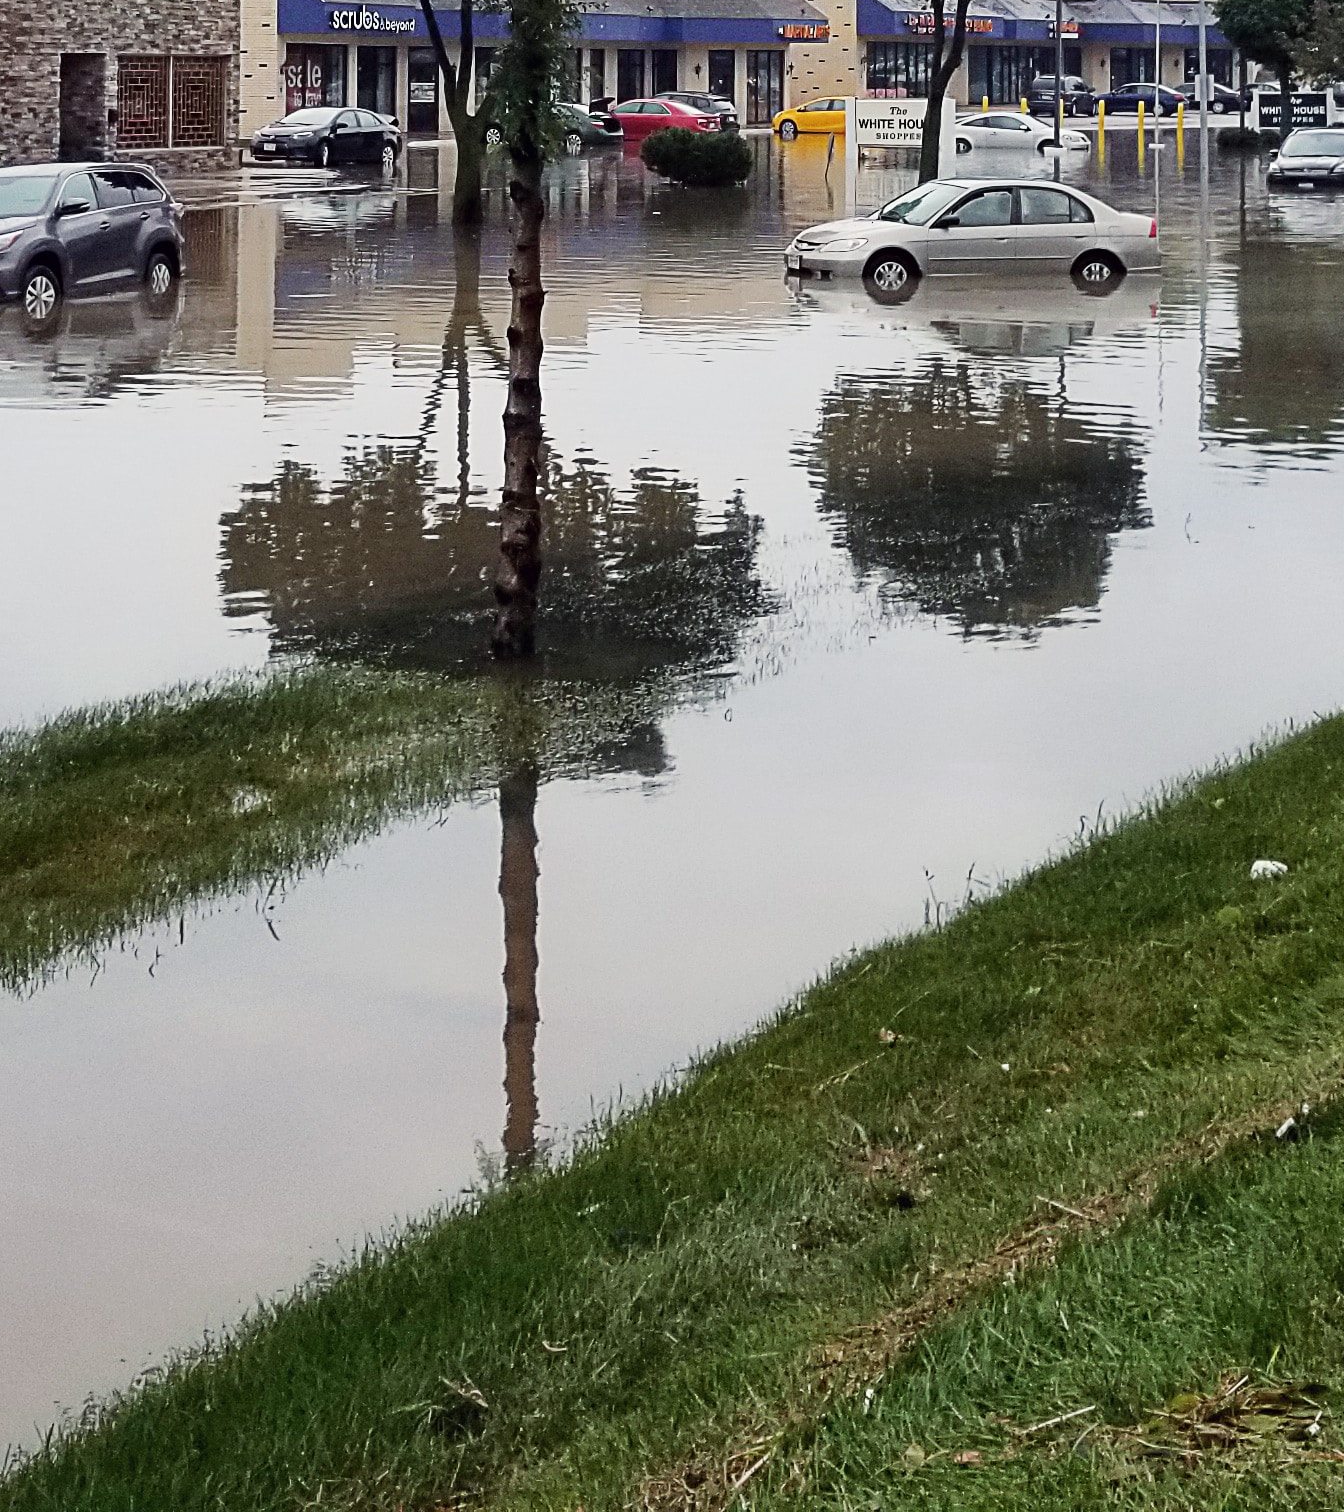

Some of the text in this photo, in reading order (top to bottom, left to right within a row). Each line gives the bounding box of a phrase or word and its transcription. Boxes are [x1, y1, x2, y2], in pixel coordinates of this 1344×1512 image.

[333, 5, 380, 30] scrubs
[386, 19, 416, 34] beyond
[287, 59, 322, 88] sale
[1290, 96, 1302, 104] he
[890, 106, 908, 116] The
[1260, 105, 1325, 115] WHIT HOUSE
[858, 118, 925, 130] WHITE HOU
[875, 132, 922, 141] SHOPPES
